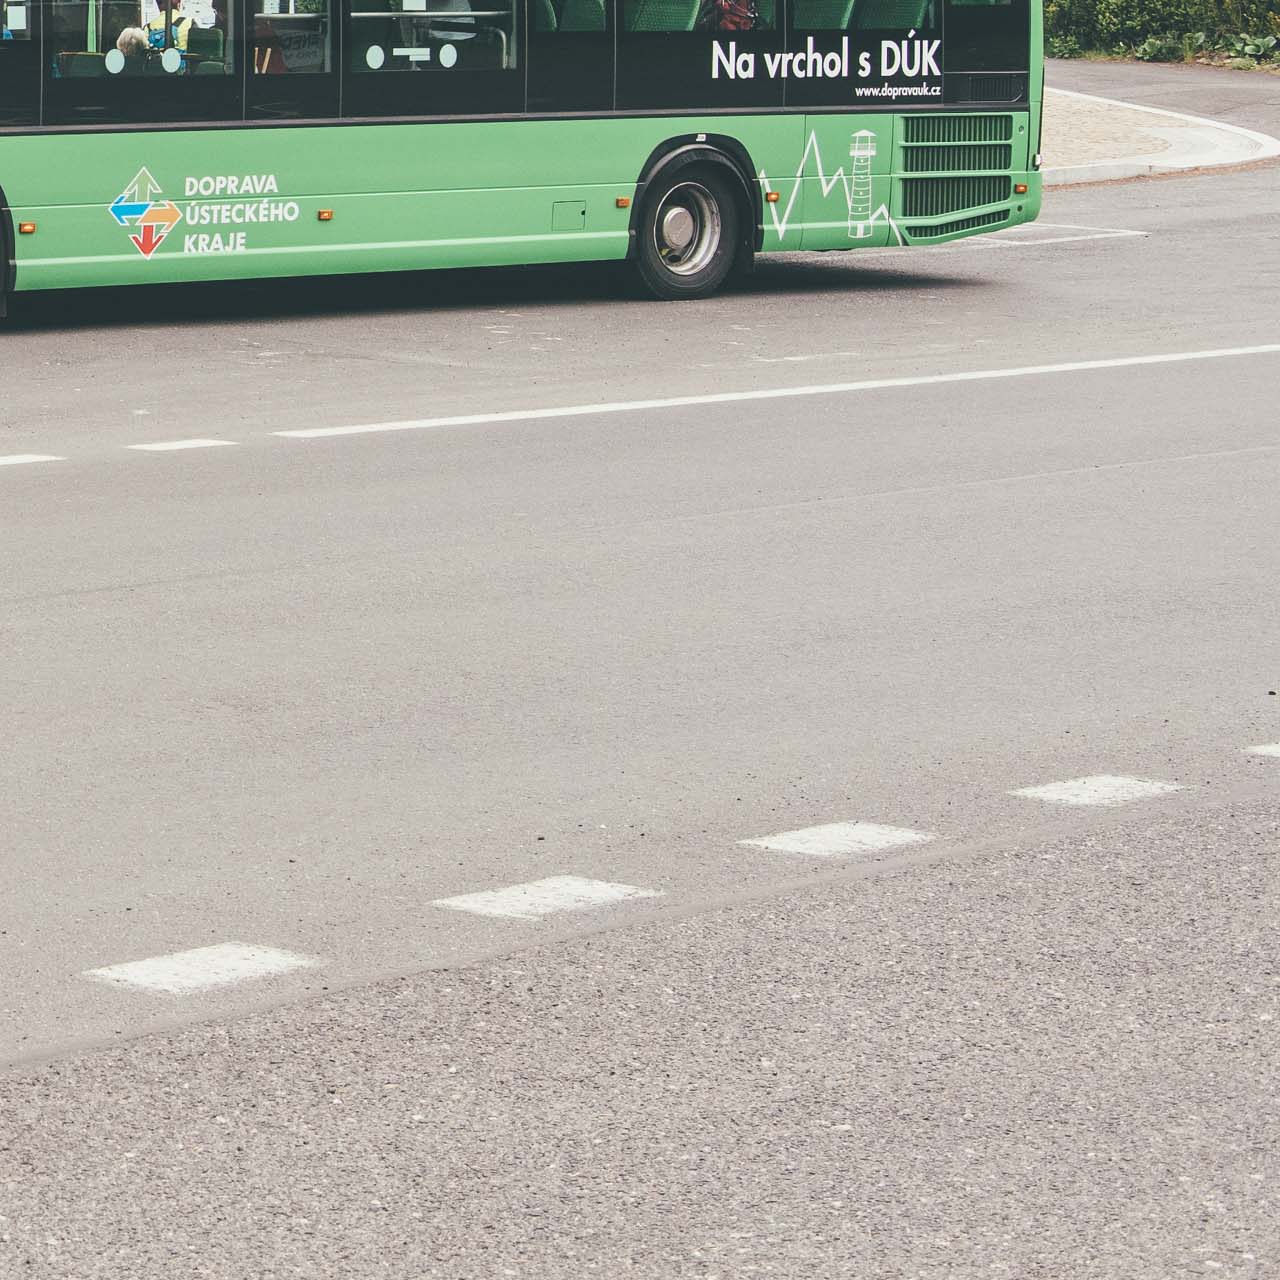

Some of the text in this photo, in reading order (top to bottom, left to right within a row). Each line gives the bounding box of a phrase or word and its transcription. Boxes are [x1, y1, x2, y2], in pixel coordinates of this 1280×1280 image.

[711, 28, 942, 80] Na vrchol s DÚK
[855, 82, 942, 100] www.dopravauk.cz
[184, 174, 279, 196] DOPRAVA
[185, 199, 300, 225] ÚSTECKÉHO
[184, 231, 247, 256] KRAJE
